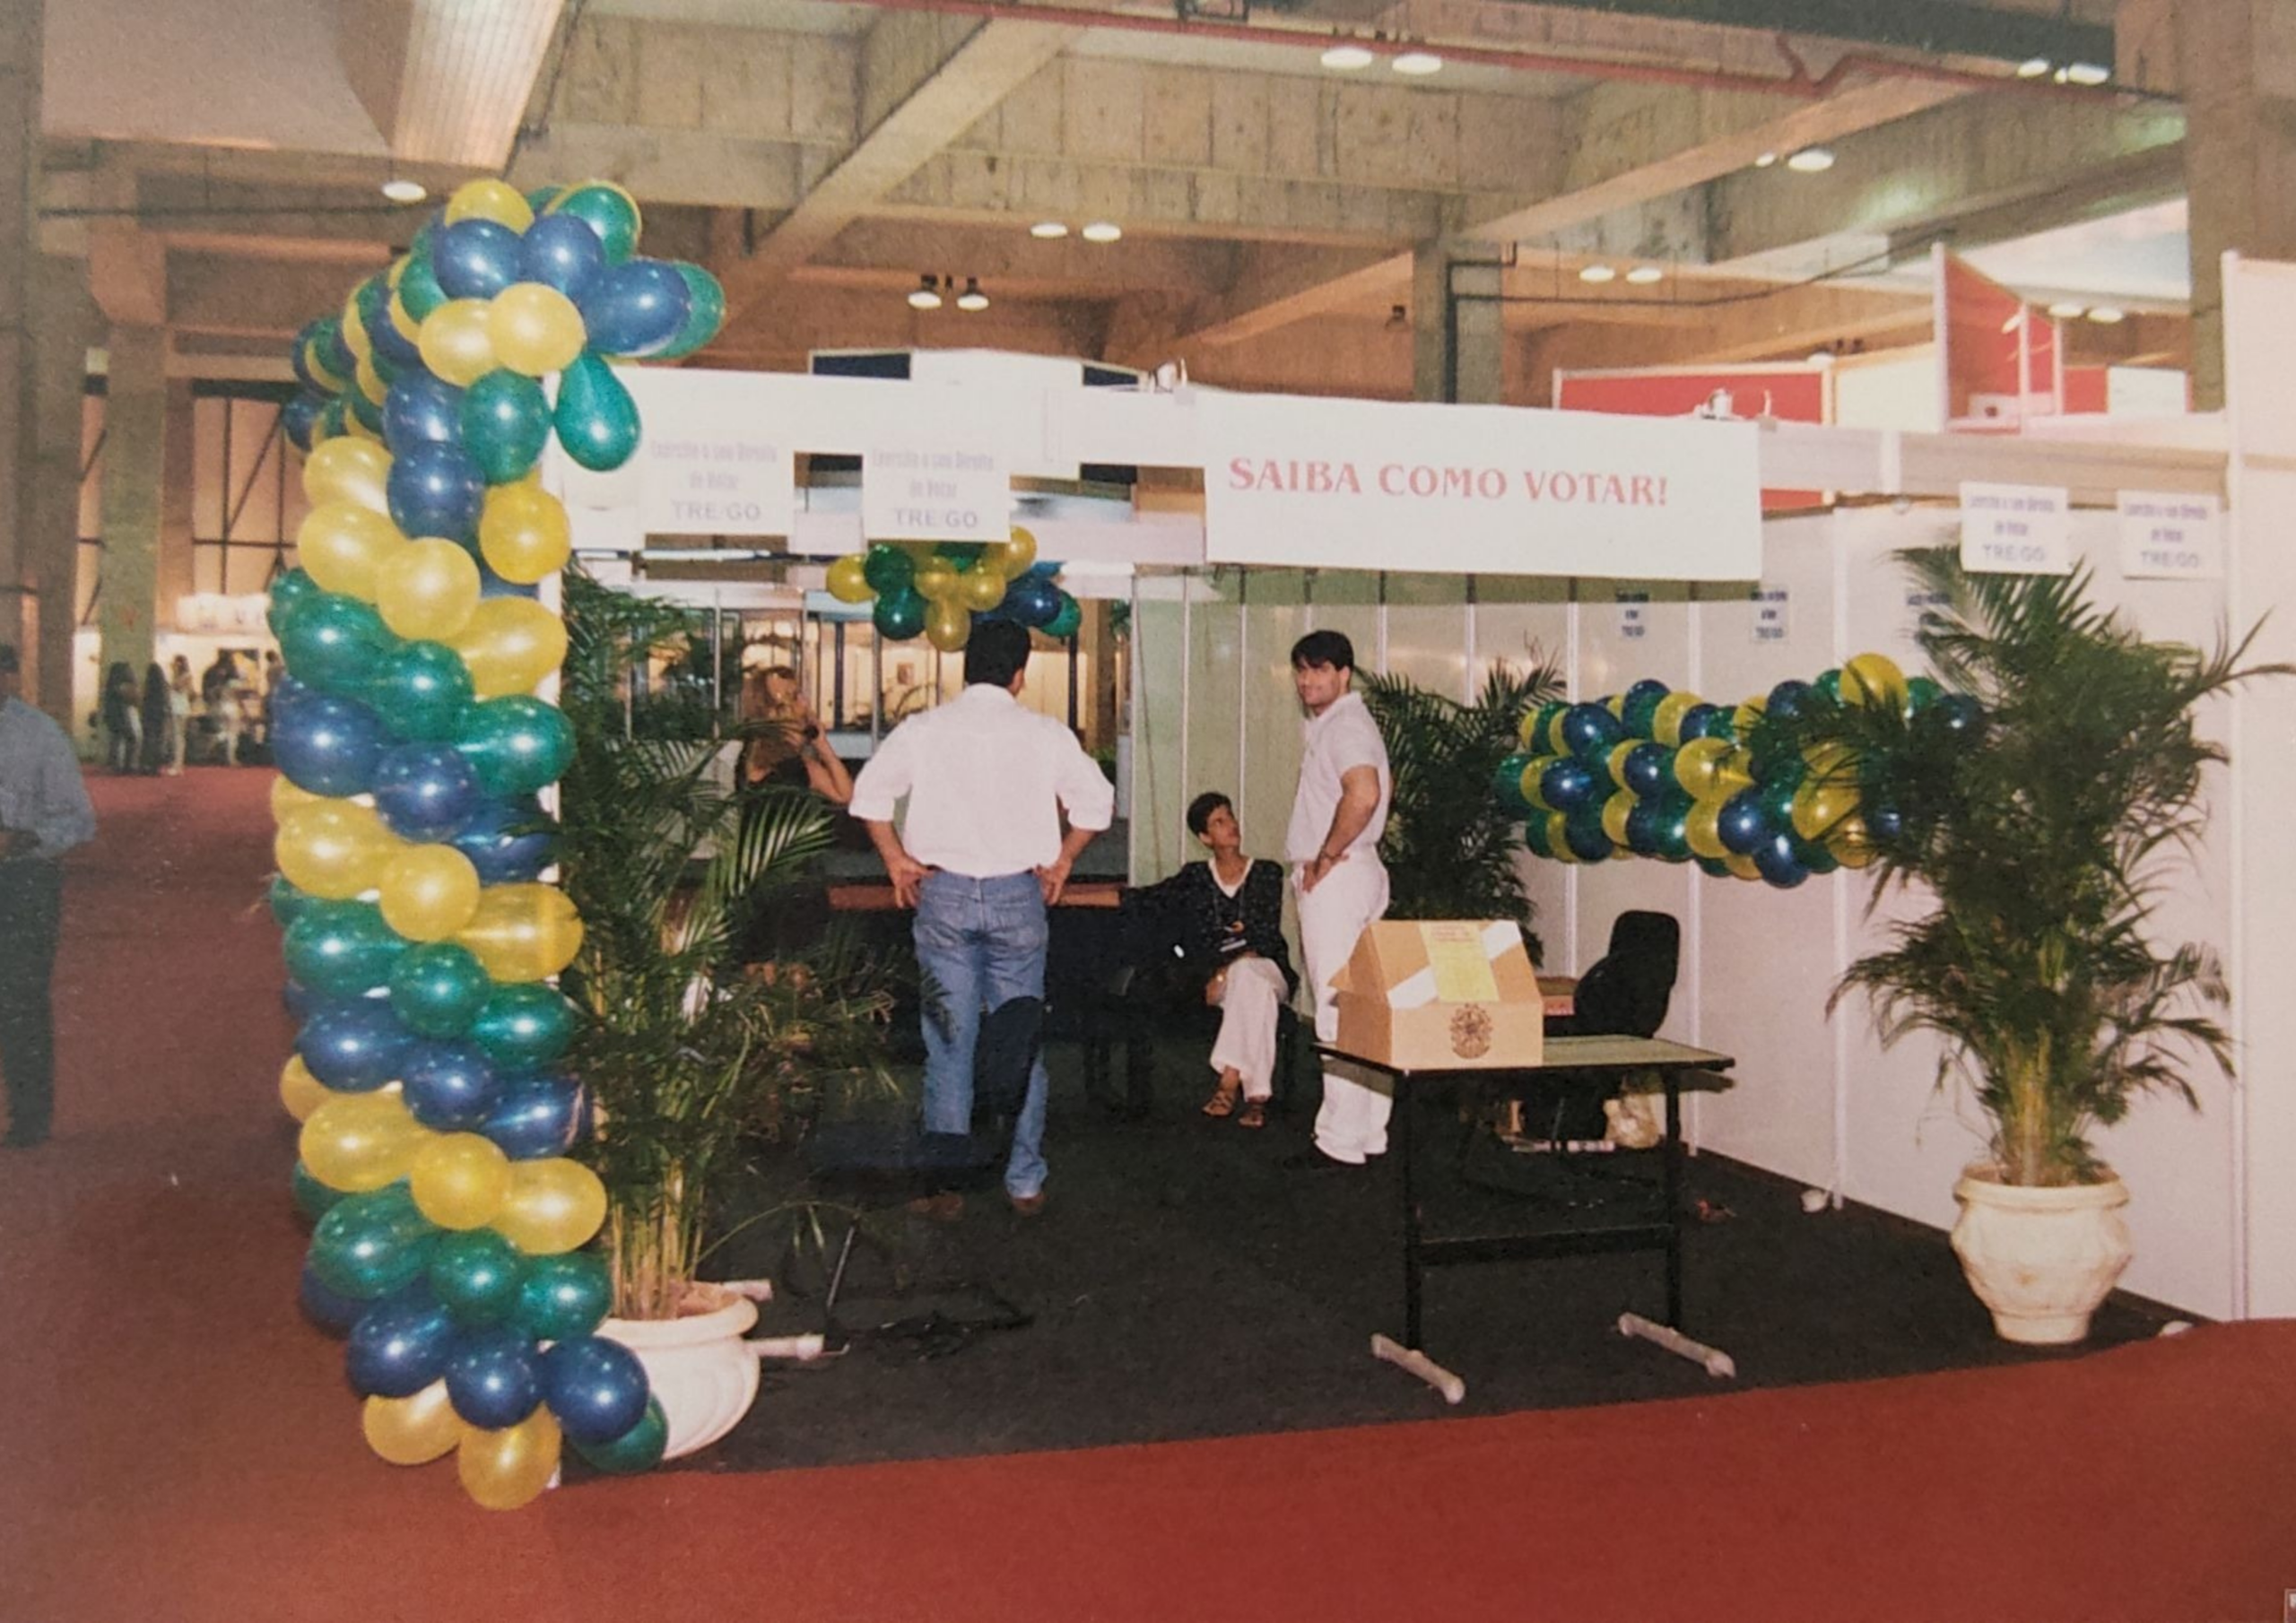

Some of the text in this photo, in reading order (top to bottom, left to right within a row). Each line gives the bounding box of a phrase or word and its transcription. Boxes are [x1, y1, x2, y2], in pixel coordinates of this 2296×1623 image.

[1229, 456, 1668, 506] SAIBA COMO VOTAR!
